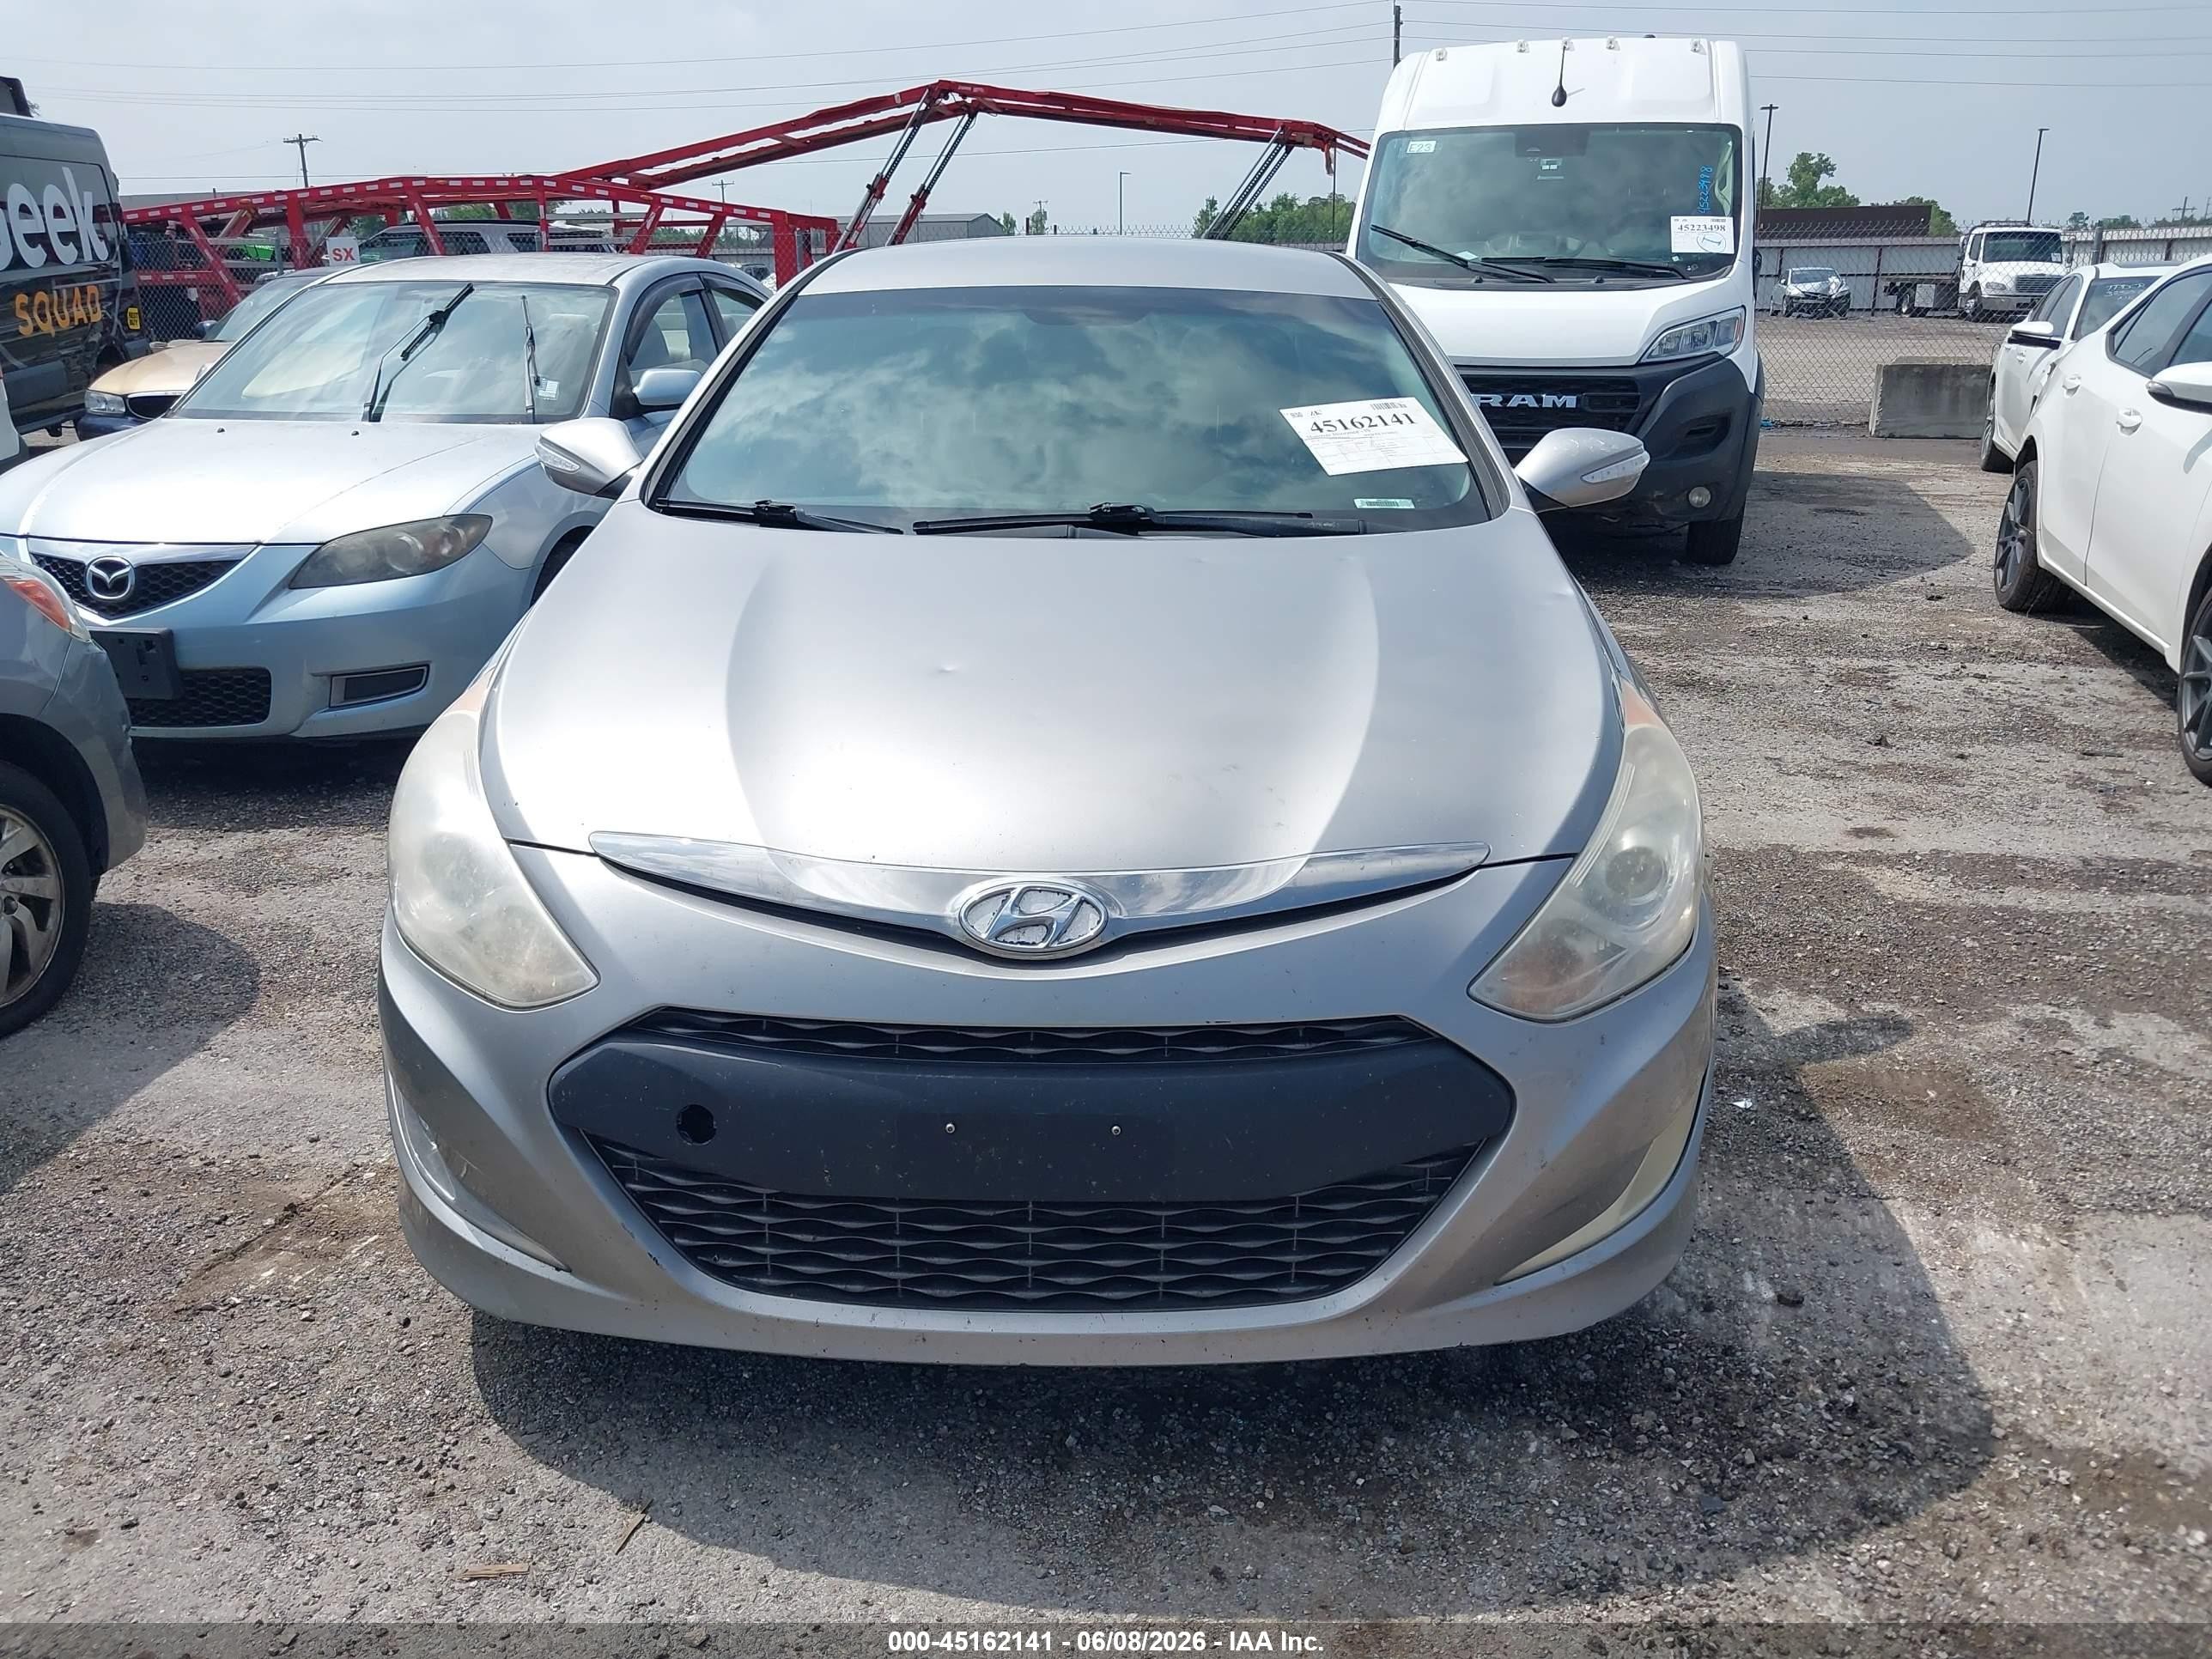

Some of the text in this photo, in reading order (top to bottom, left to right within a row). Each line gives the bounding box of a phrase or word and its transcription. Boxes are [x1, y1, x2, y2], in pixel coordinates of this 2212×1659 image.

[0, 167, 109, 270] eek
[332, 247, 356, 262] SX
[15, 284, 102, 337] SQUAD
[1470, 393, 1577, 408] RAM
[1310, 412, 1417, 434] 45162141
